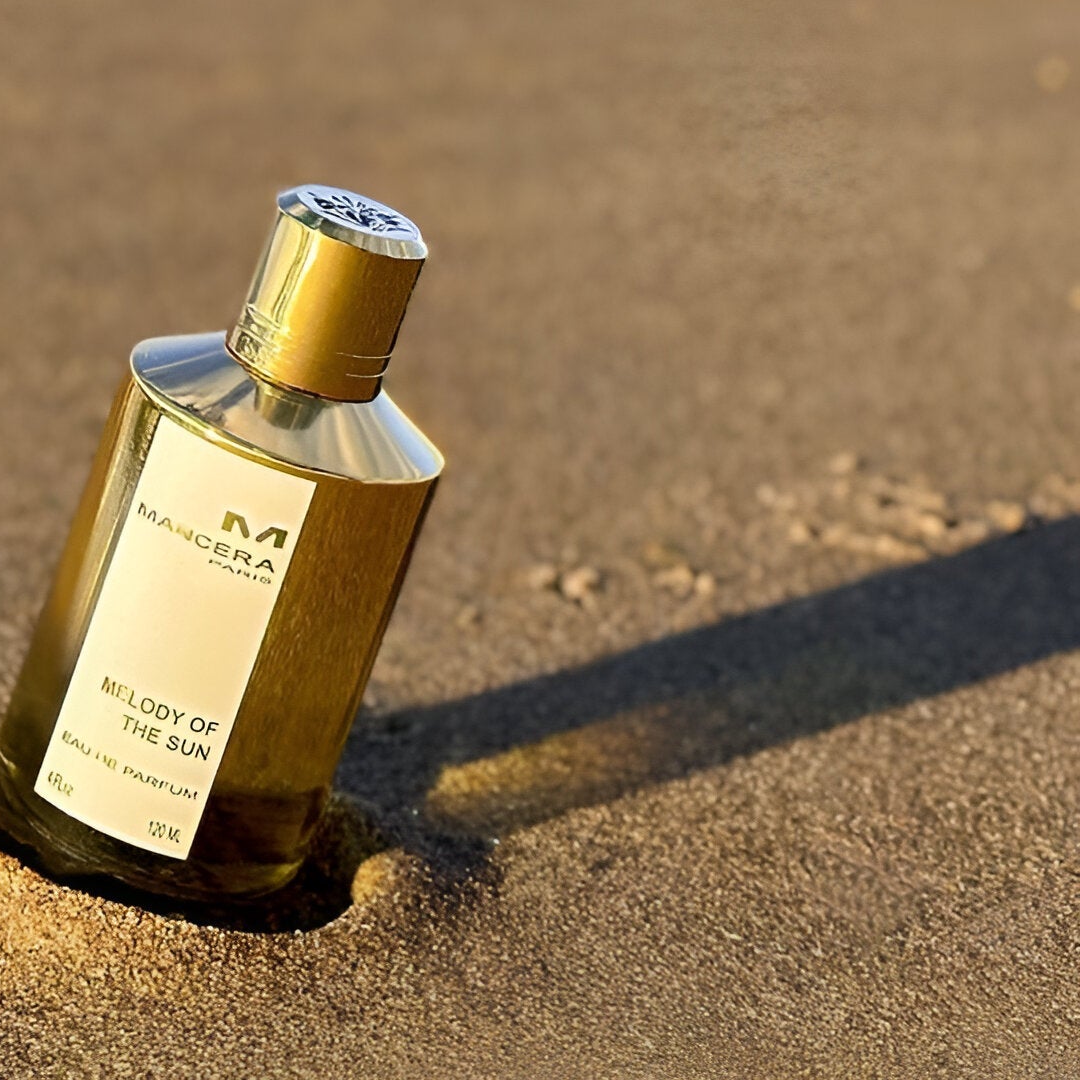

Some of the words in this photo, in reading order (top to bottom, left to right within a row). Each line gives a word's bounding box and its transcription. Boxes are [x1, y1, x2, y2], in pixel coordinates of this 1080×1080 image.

[137, 501, 275, 574] MANCERA
[100, 676, 185, 726] MELODY
[189, 716, 220, 736] OF
[122, 714, 162, 745] THE
[165, 735, 212, 761] SUN
[61, 730, 92, 756] EAU
[123, 765, 198, 800] PARFUM
